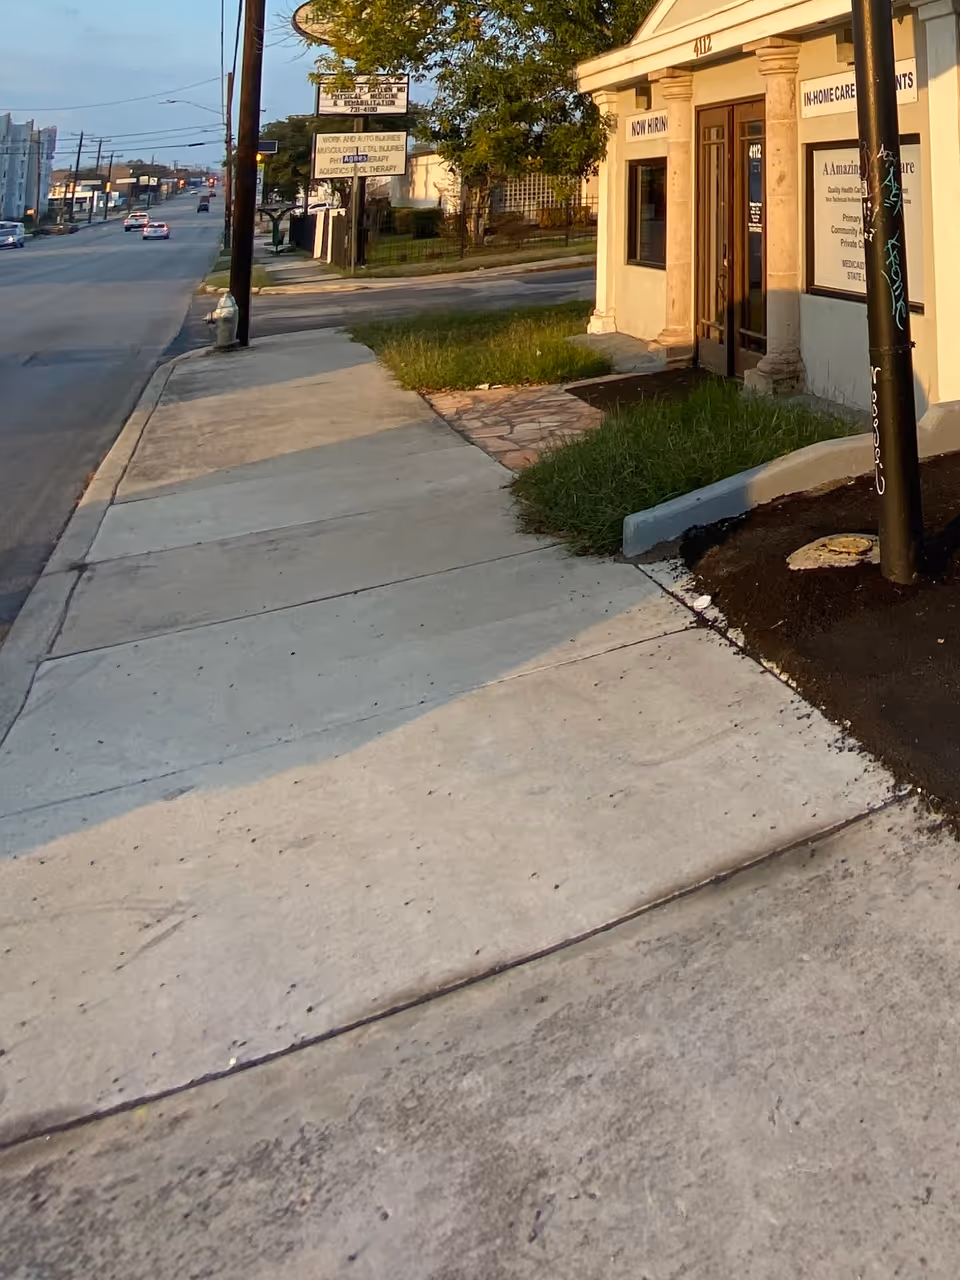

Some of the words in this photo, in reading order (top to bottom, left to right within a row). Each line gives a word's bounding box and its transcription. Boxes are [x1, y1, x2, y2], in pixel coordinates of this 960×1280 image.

[693, 34, 713, 58] 4112
[803, 87, 834, 107] IN-HOME
[834, 82, 856, 101] CARE
[631, 119, 646, 137] NOW
[321, 136, 342, 144] WORK
[342, 135, 357, 143] AND
[357, 134, 375, 142] AUTO
[374, 134, 401, 142] INJURIES
[748, 143, 762, 159] 4112
[343, 155, 368, 163] Agnes
[319, 166, 350, 175] AQUATICS
[368, 164, 397, 173] THERAPY
[823, 162, 829, 176] A
[842, 213, 861, 225] Primary
[830, 225, 858, 238] Community
[840, 238, 857, 249] Private
[841, 259, 864, 270] MEDICAID
[846, 271, 862, 281] STATE
